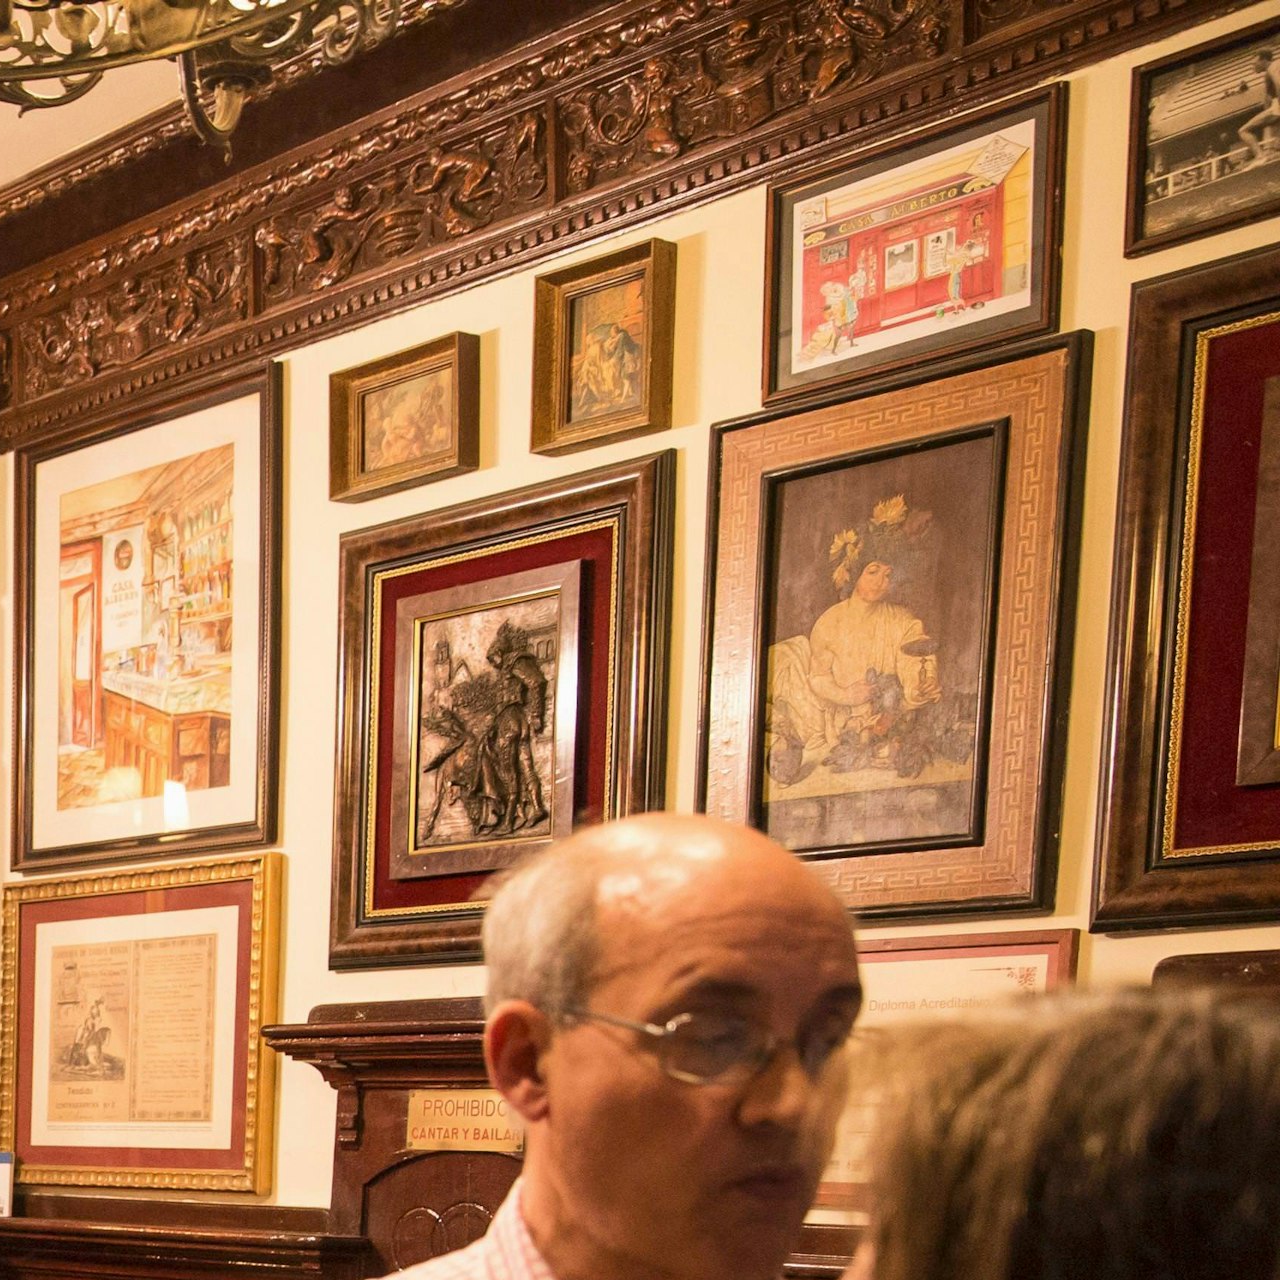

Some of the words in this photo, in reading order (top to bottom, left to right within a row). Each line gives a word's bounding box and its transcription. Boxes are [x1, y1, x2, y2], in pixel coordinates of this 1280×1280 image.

[839, 214, 874, 233] CASA
[891, 187, 958, 217] ALBERTO
[869, 999, 916, 1012] Diploma
[411, 1127, 458, 1141] CANTAR
[462, 1127, 471, 1141] Y
